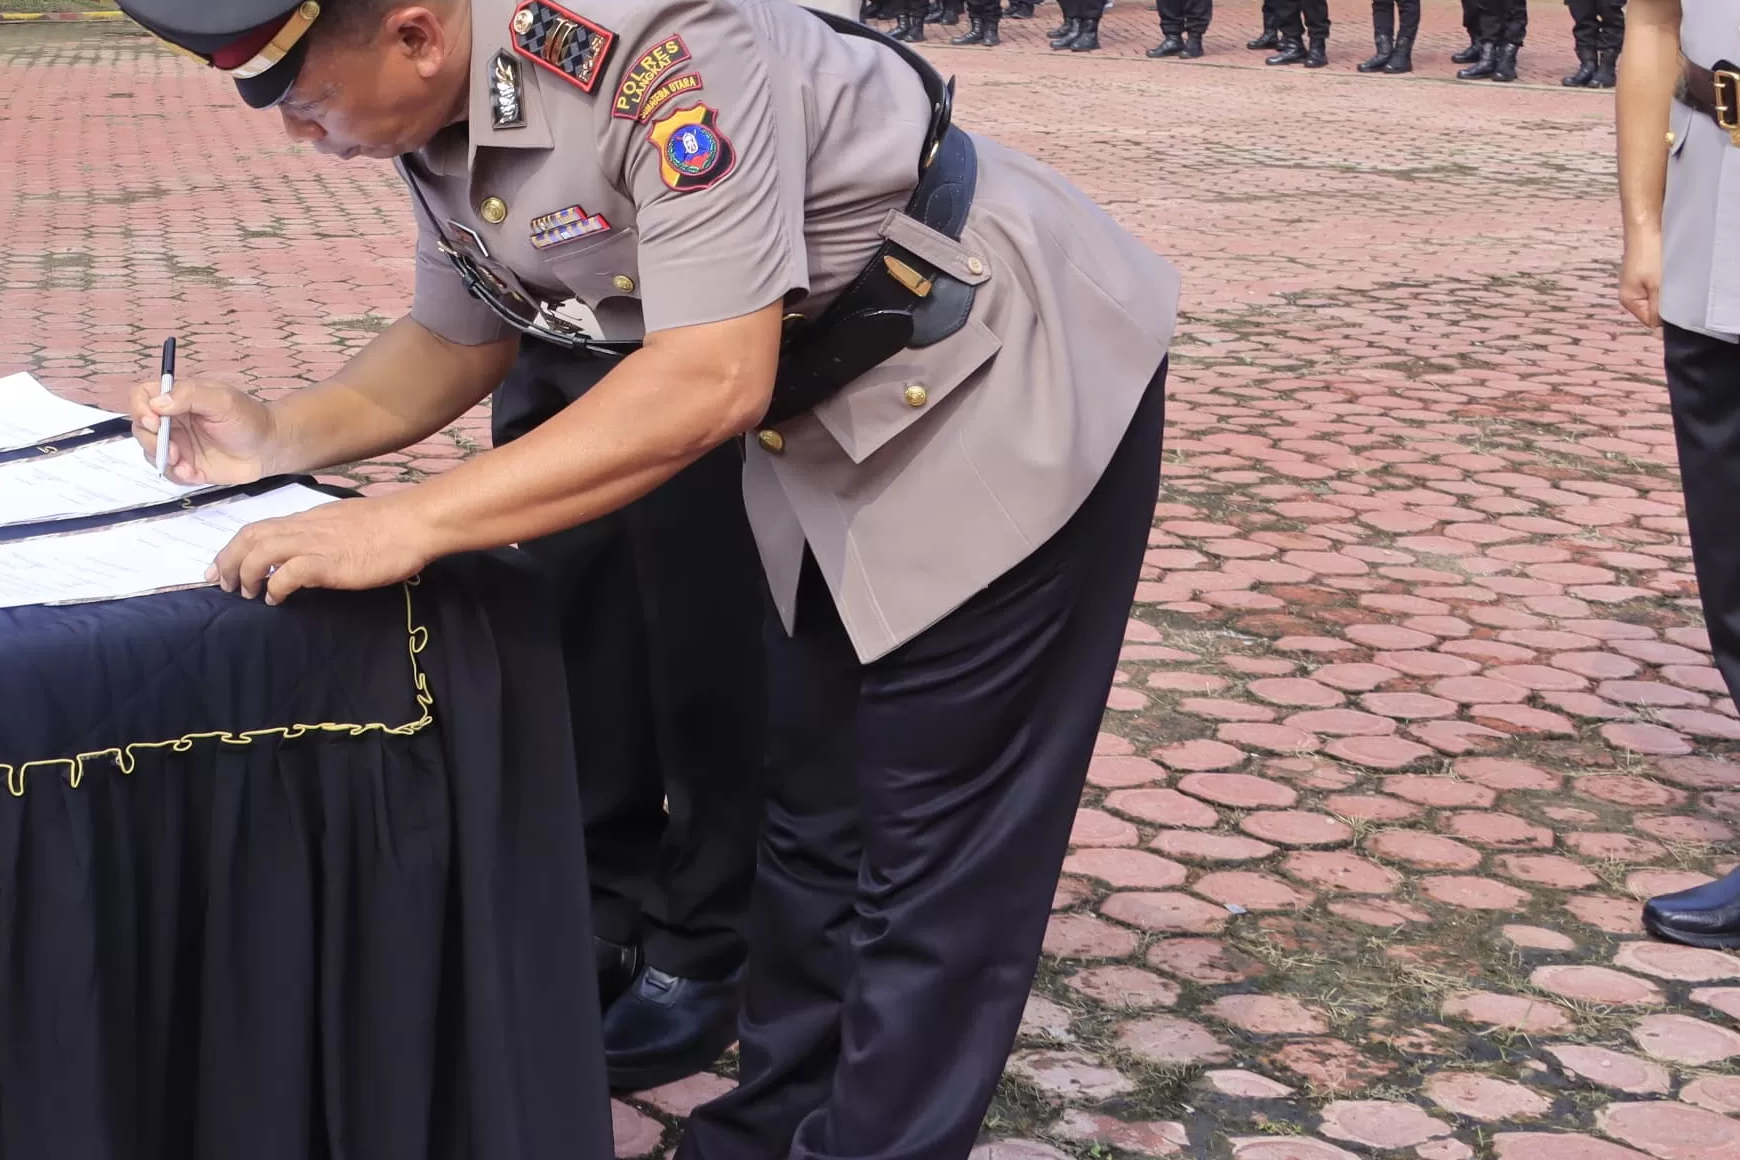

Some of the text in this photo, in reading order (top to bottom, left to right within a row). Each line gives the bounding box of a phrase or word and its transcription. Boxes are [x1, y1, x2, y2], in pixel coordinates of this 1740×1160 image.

[617, 41, 679, 109] POLRES
[631, 55, 671, 103] LANGKAT
[667, 76, 697, 92] UTARA
